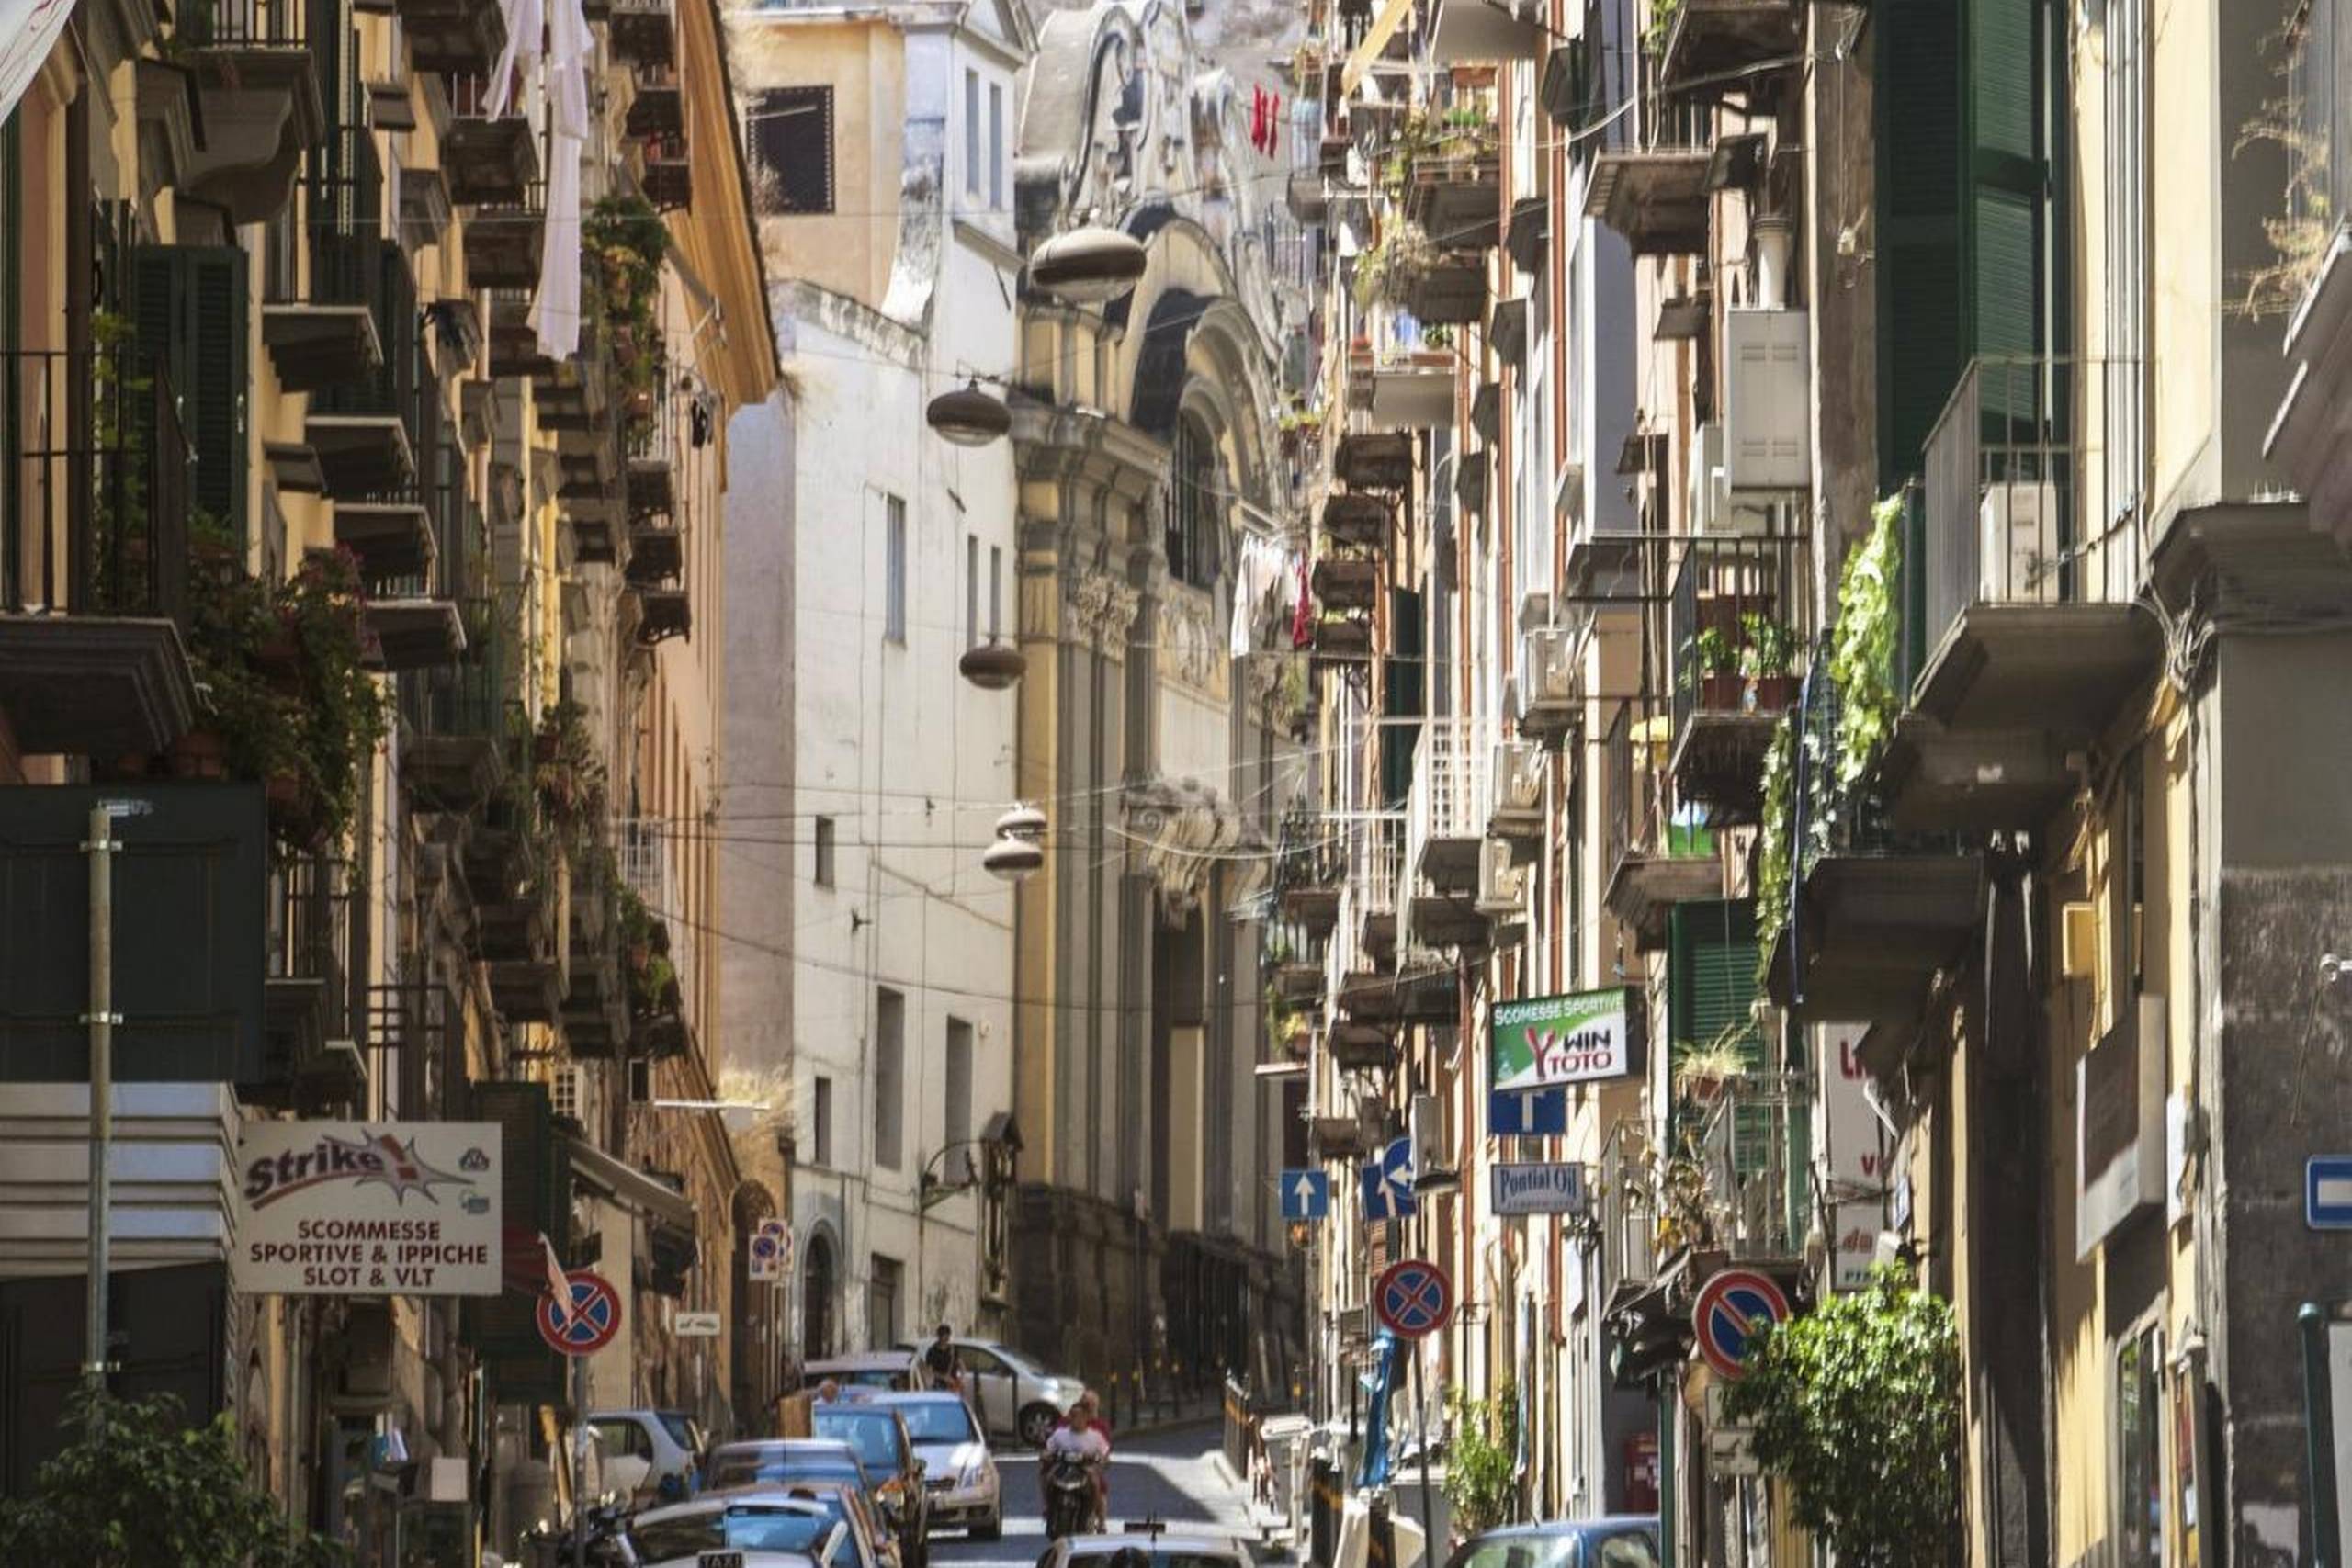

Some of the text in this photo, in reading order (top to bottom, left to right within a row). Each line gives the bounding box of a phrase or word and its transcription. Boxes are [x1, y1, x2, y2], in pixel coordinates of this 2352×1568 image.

[1563, 990, 1623, 1017] SPORTIVE
[1564, 1029, 1611, 1052] WIN
[1548, 1051, 1612, 1075] TOTO
[1555, 1166, 1577, 1200] Oil
[298, 1220, 440, 1241] SCOMMESSE
[250, 1245, 488, 1265] SPORTIVE & IPPICHE
[303, 1267, 435, 1287] SLOT & VLT
